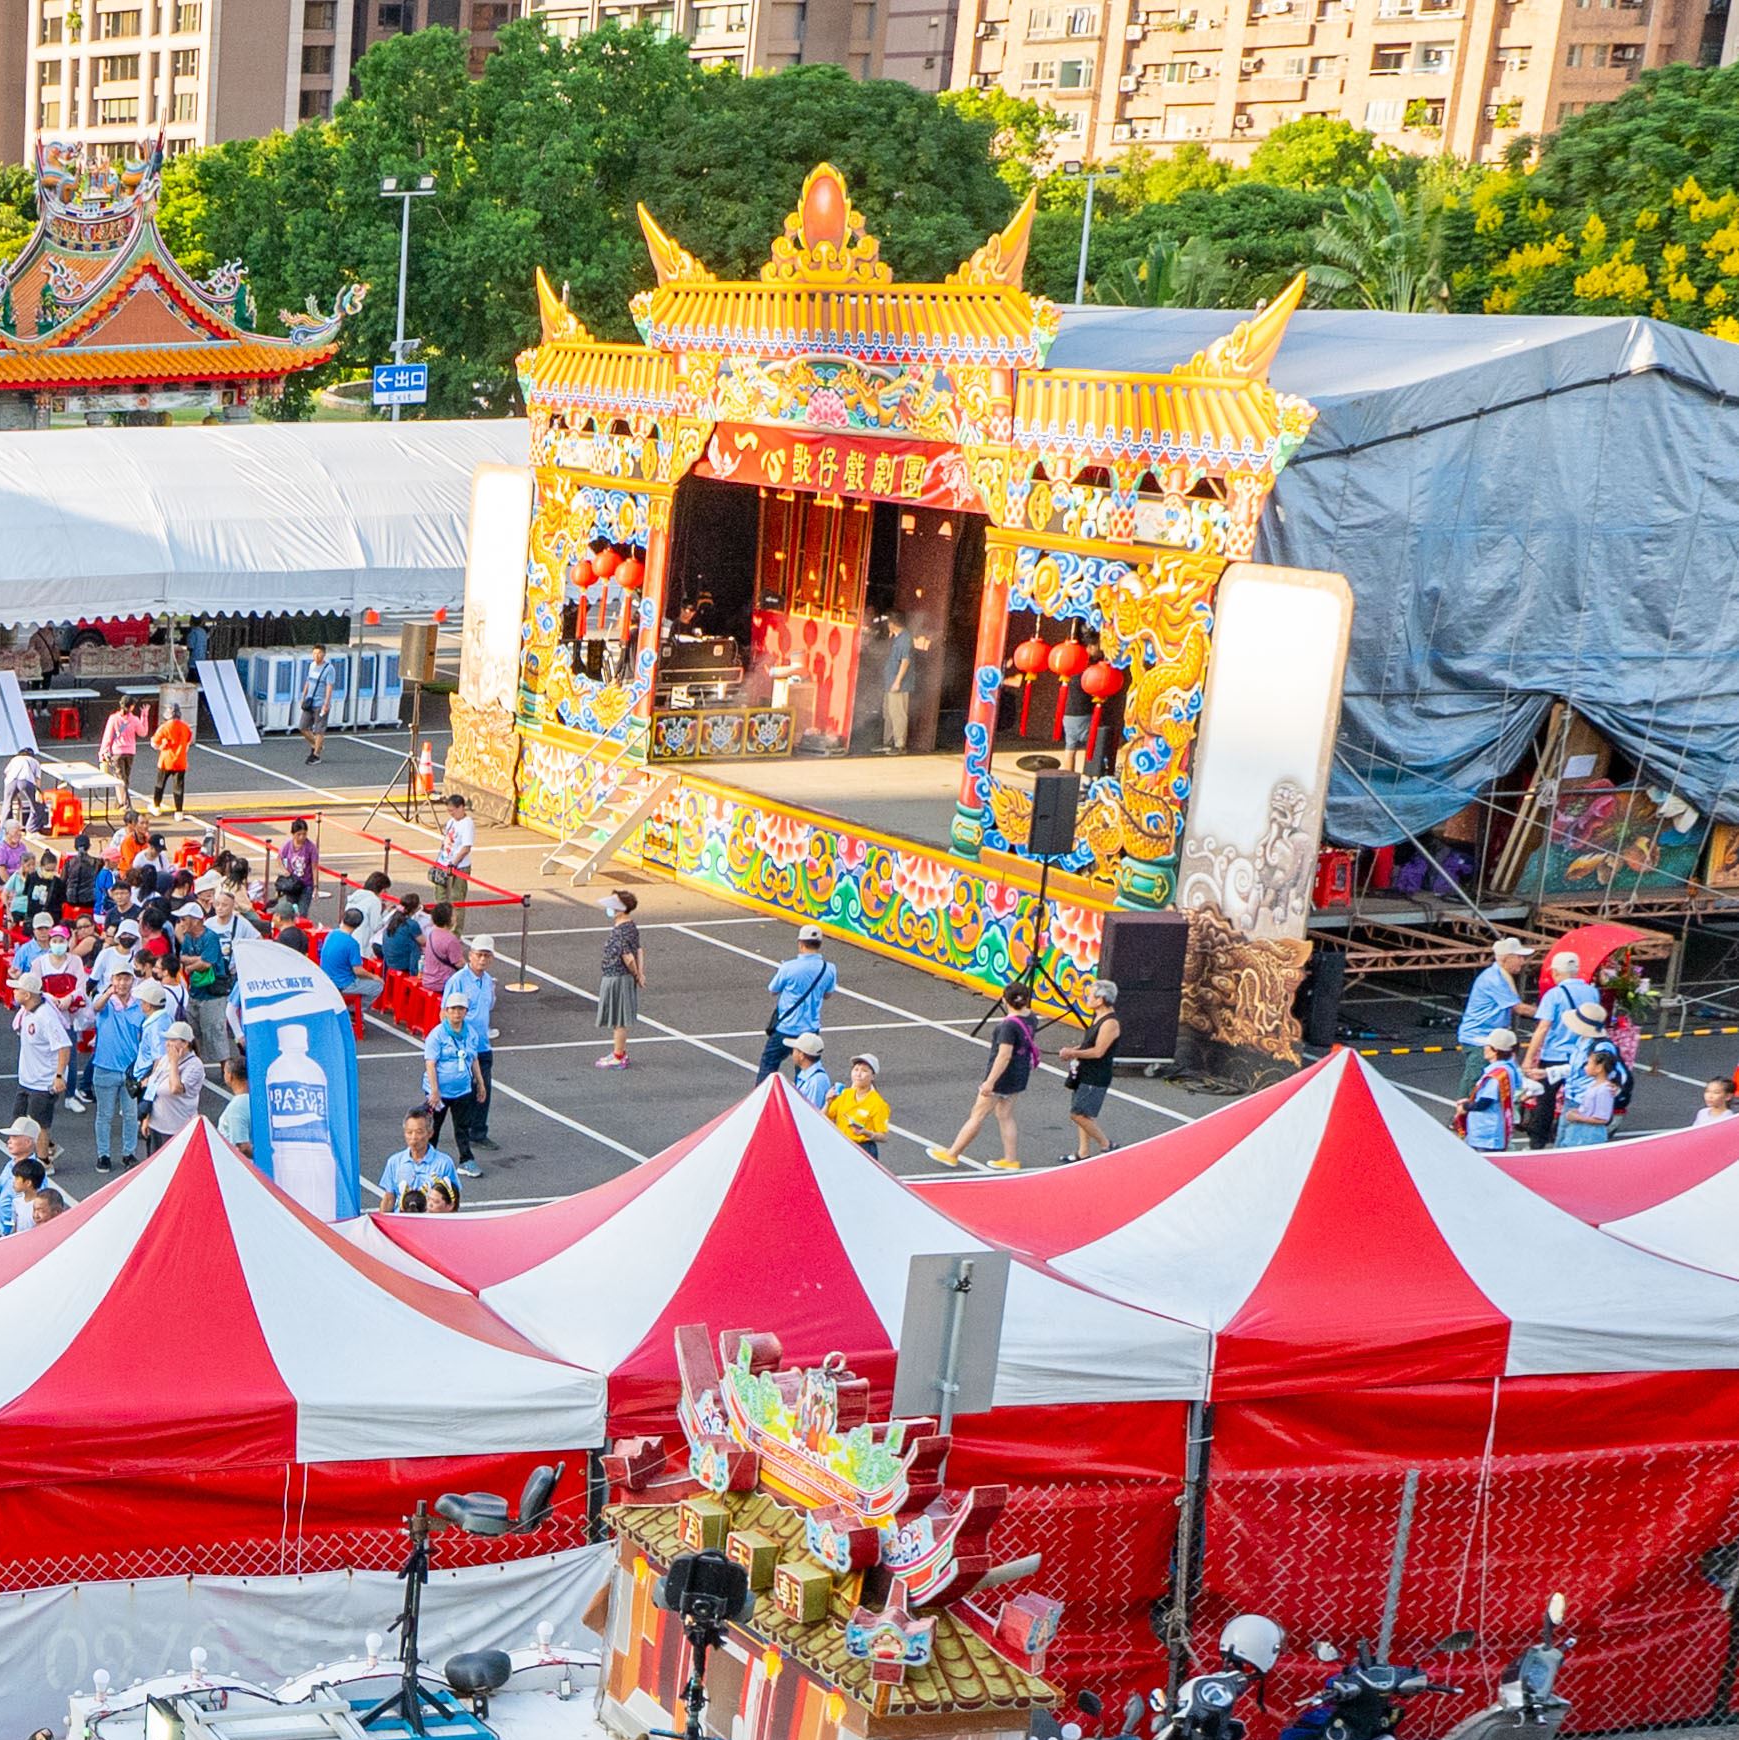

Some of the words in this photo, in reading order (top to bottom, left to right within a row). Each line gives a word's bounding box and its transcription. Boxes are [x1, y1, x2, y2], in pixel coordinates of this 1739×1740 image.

[394, 372, 425, 387] 出口
[388, 392, 412, 402] Exit
[734, 431, 928, 499] 一心歌仔戲劇團
